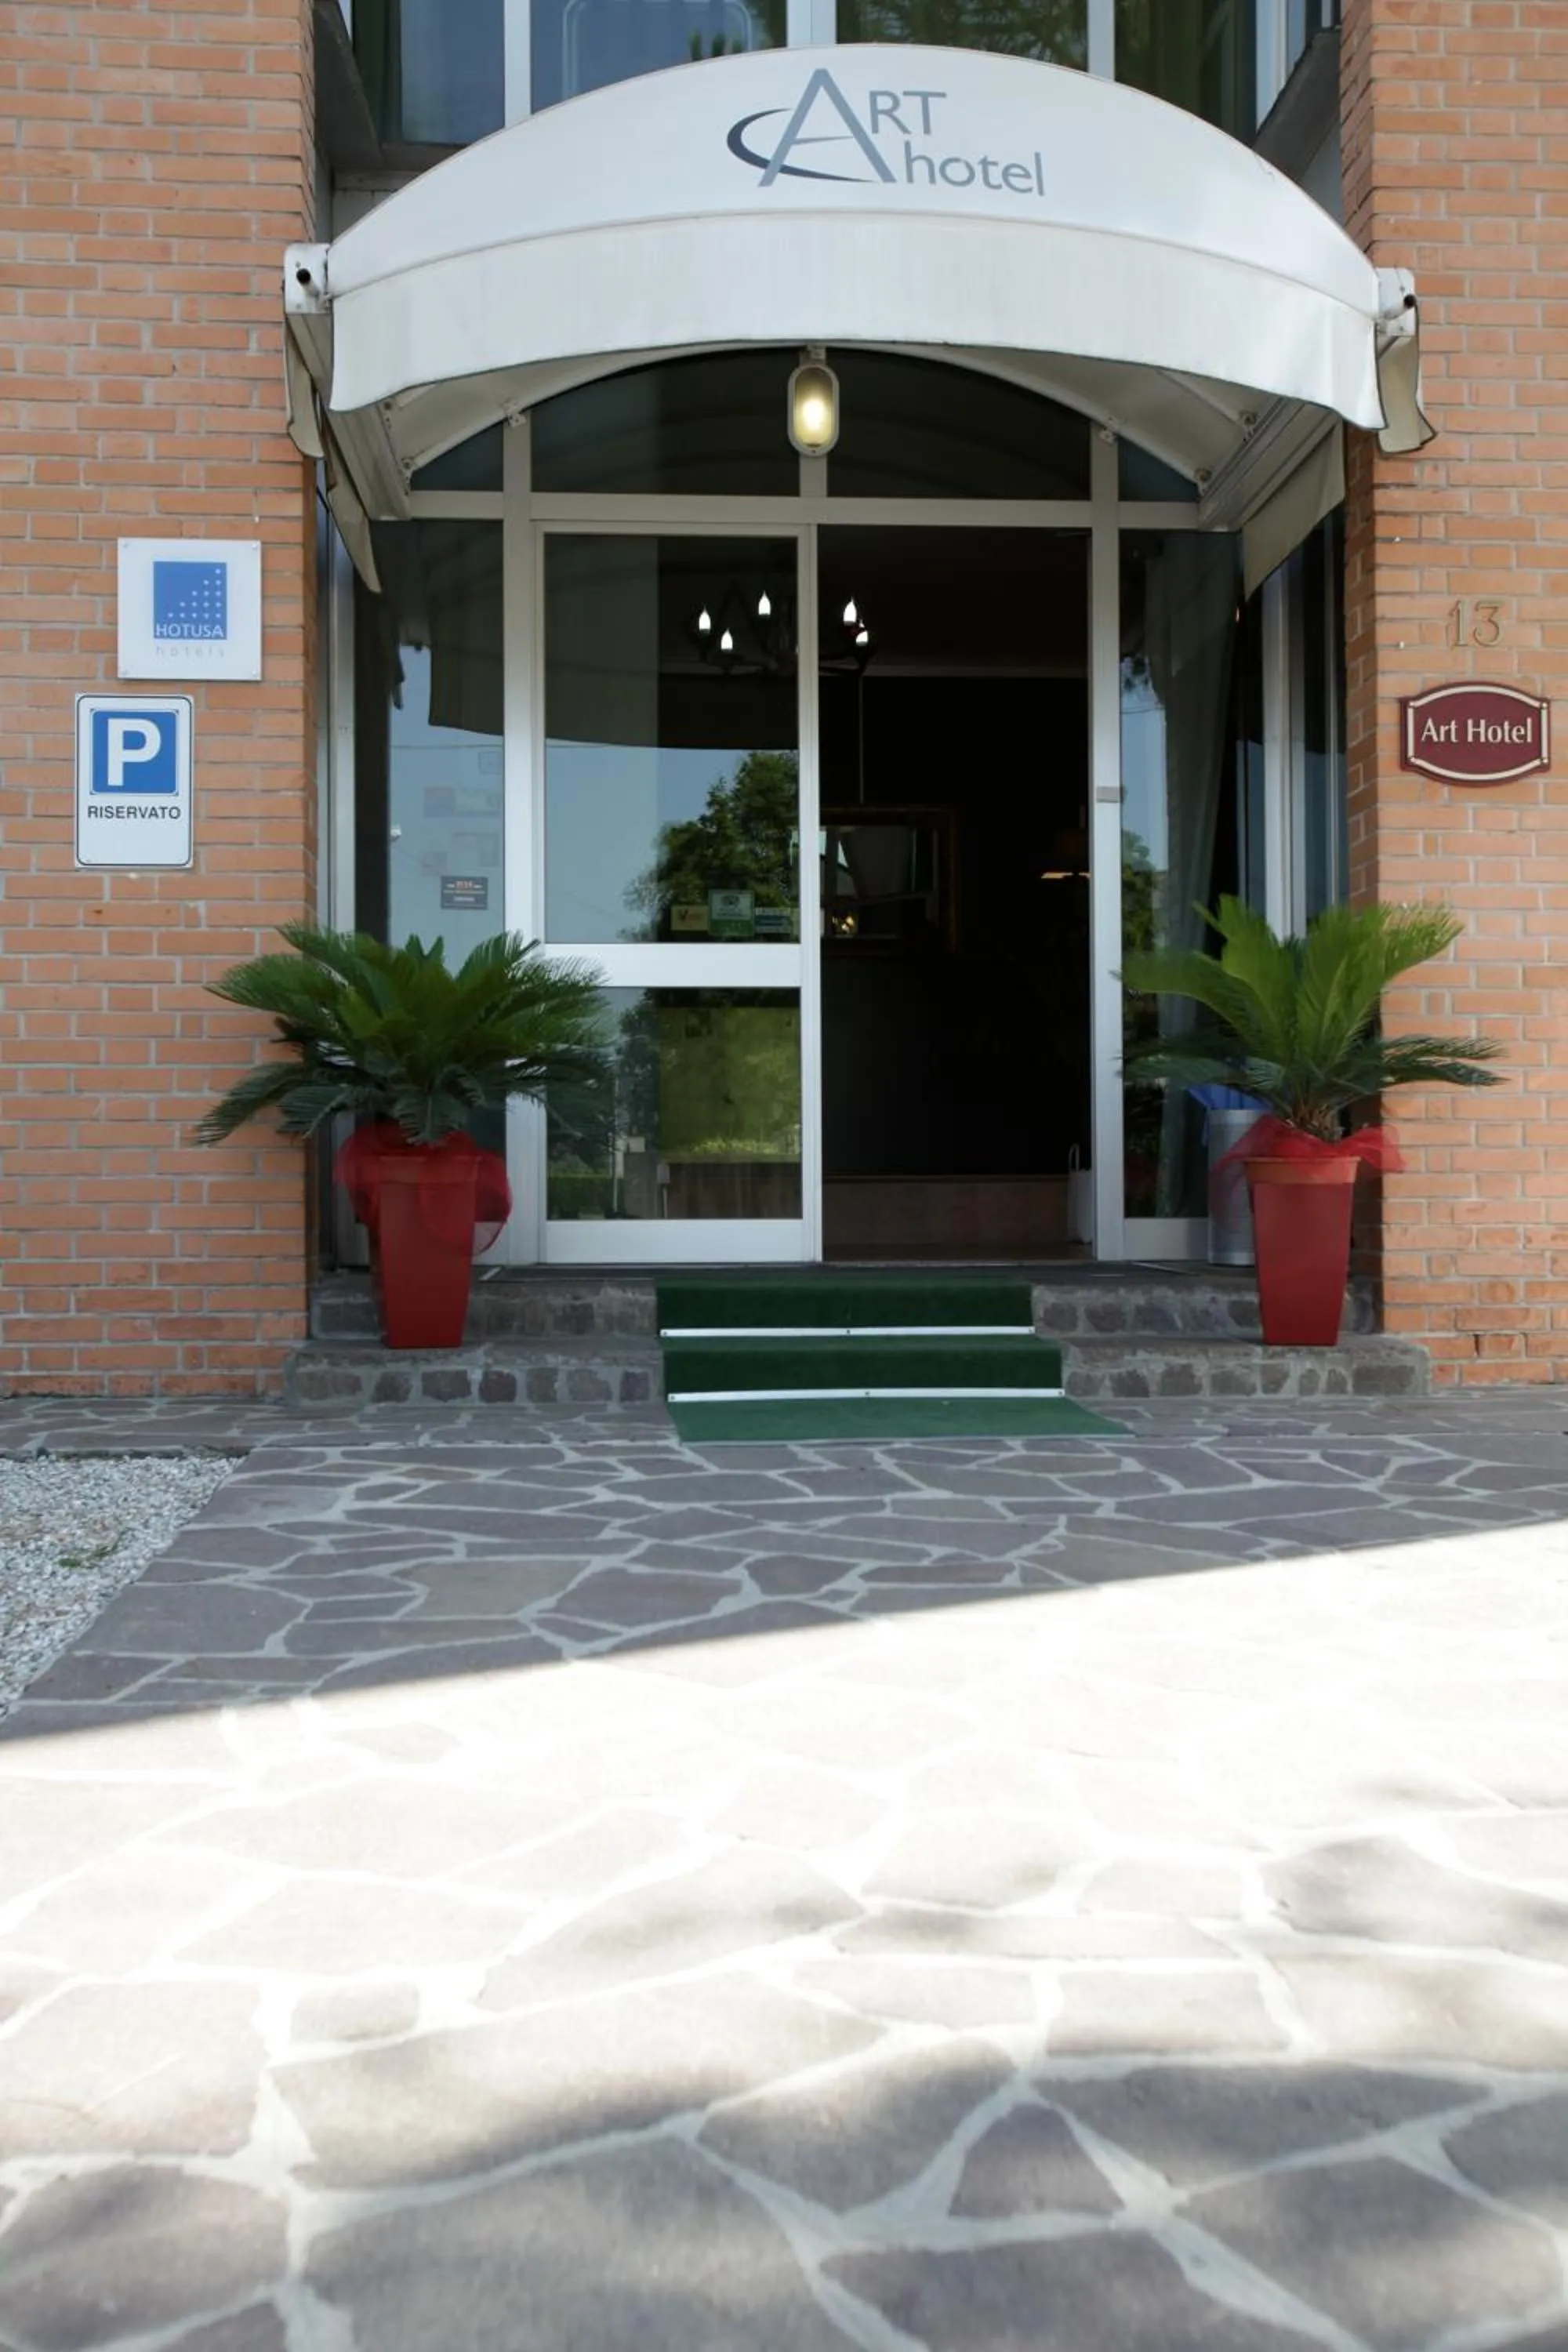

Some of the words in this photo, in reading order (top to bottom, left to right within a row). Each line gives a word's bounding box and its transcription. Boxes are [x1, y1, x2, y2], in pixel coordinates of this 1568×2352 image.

[757, 67, 947, 187] ART
[904, 140, 1045, 196] hotel
[155, 623, 224, 637] HOTUSA
[1449, 599, 1504, 648] 13
[107, 717, 162, 786] P
[1421, 717, 1458, 743] Art
[1466, 717, 1533, 744] Hotel
[86, 805, 182, 820] RISERVATO
